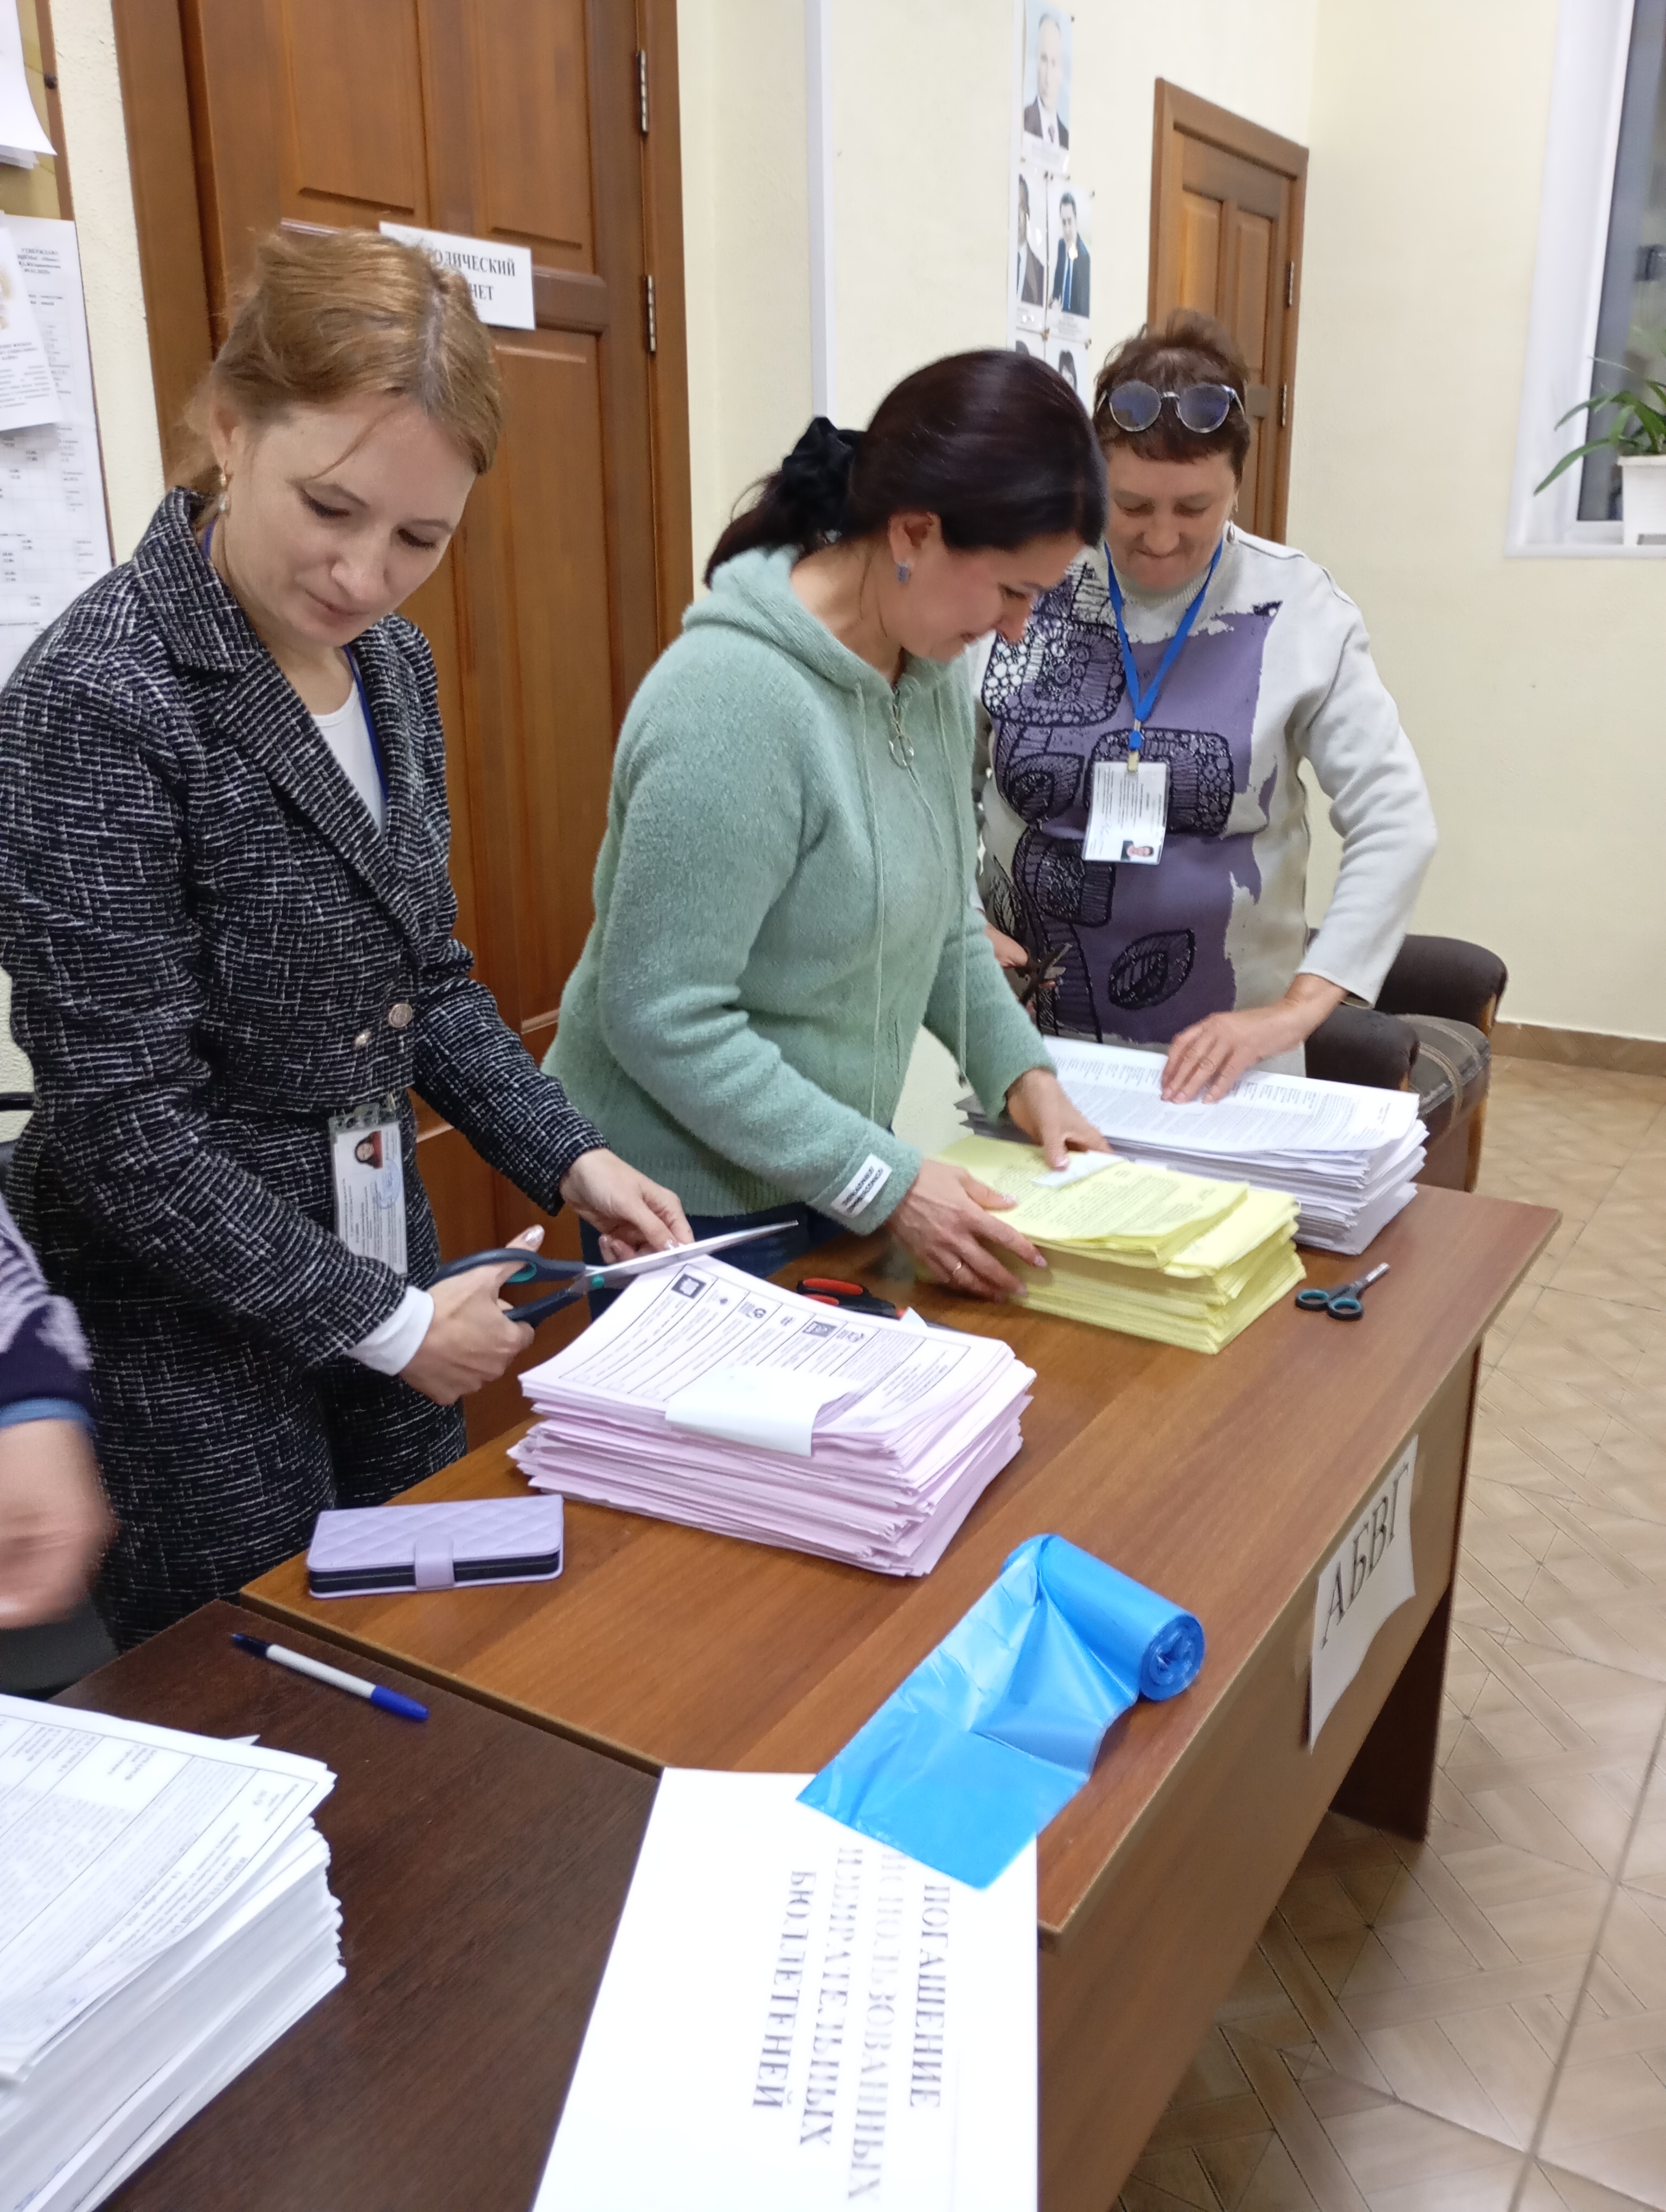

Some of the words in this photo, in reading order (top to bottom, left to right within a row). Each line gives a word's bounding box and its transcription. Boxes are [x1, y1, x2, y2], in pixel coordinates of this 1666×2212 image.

[434, 248, 515, 276] ОДИЧЕСКИЙ
[752, 1870, 817, 2108] БЮЛЛЕТЕНЕЙ
[799, 1846, 864, 2146] ИЗБИРАТЕЛЬНЫХ
[847, 1843, 907, 2201] ИСПОЛЬЗОВАННЫХ
[909, 1883, 951, 2108] ПОГАШЕНИЕ
